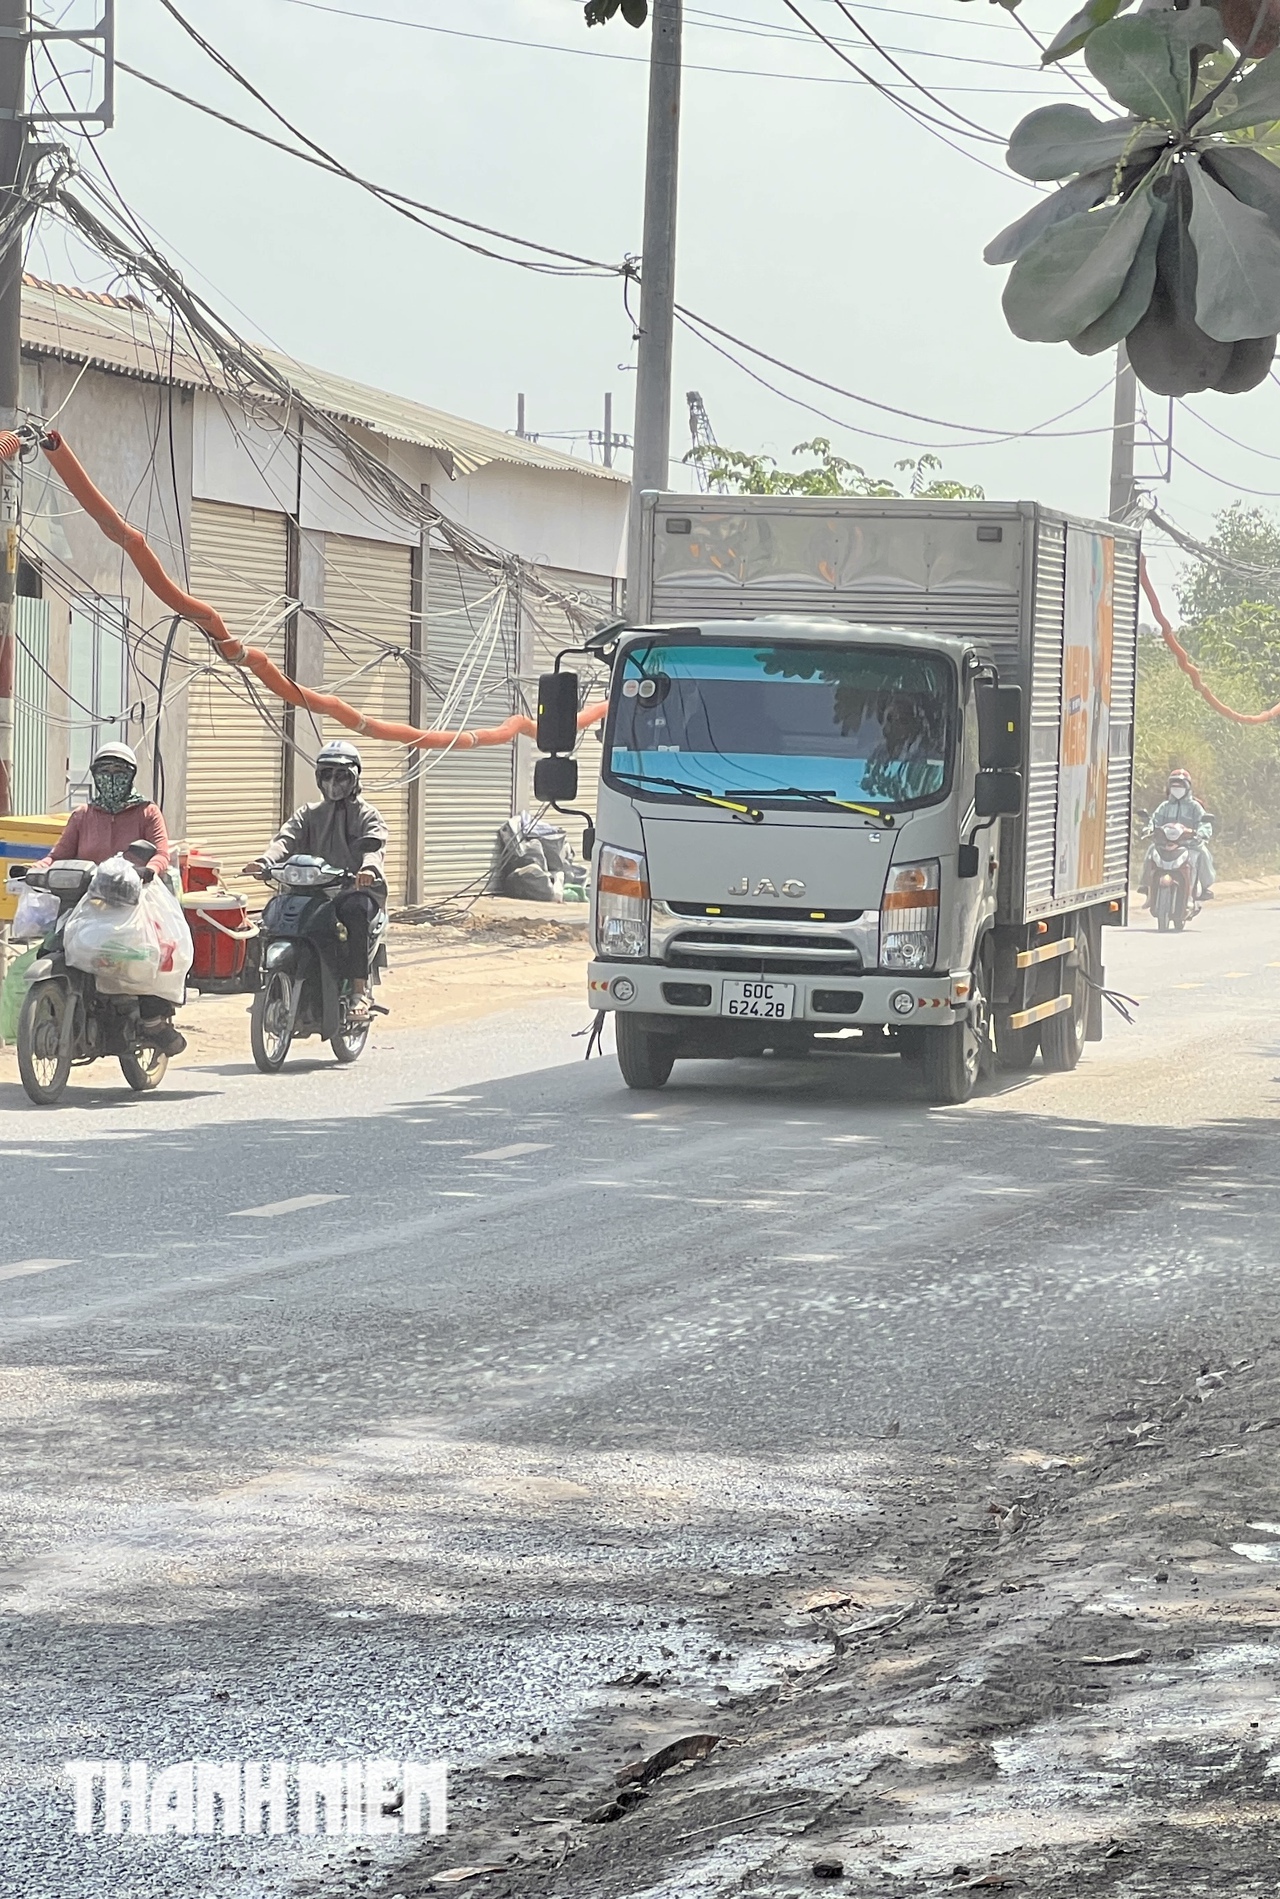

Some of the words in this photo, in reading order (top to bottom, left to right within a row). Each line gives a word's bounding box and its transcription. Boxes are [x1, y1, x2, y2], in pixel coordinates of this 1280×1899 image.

[727, 877, 806, 899] JAC
[743, 983, 774, 999] 60C
[728, 1000, 785, 1018] 624.28
